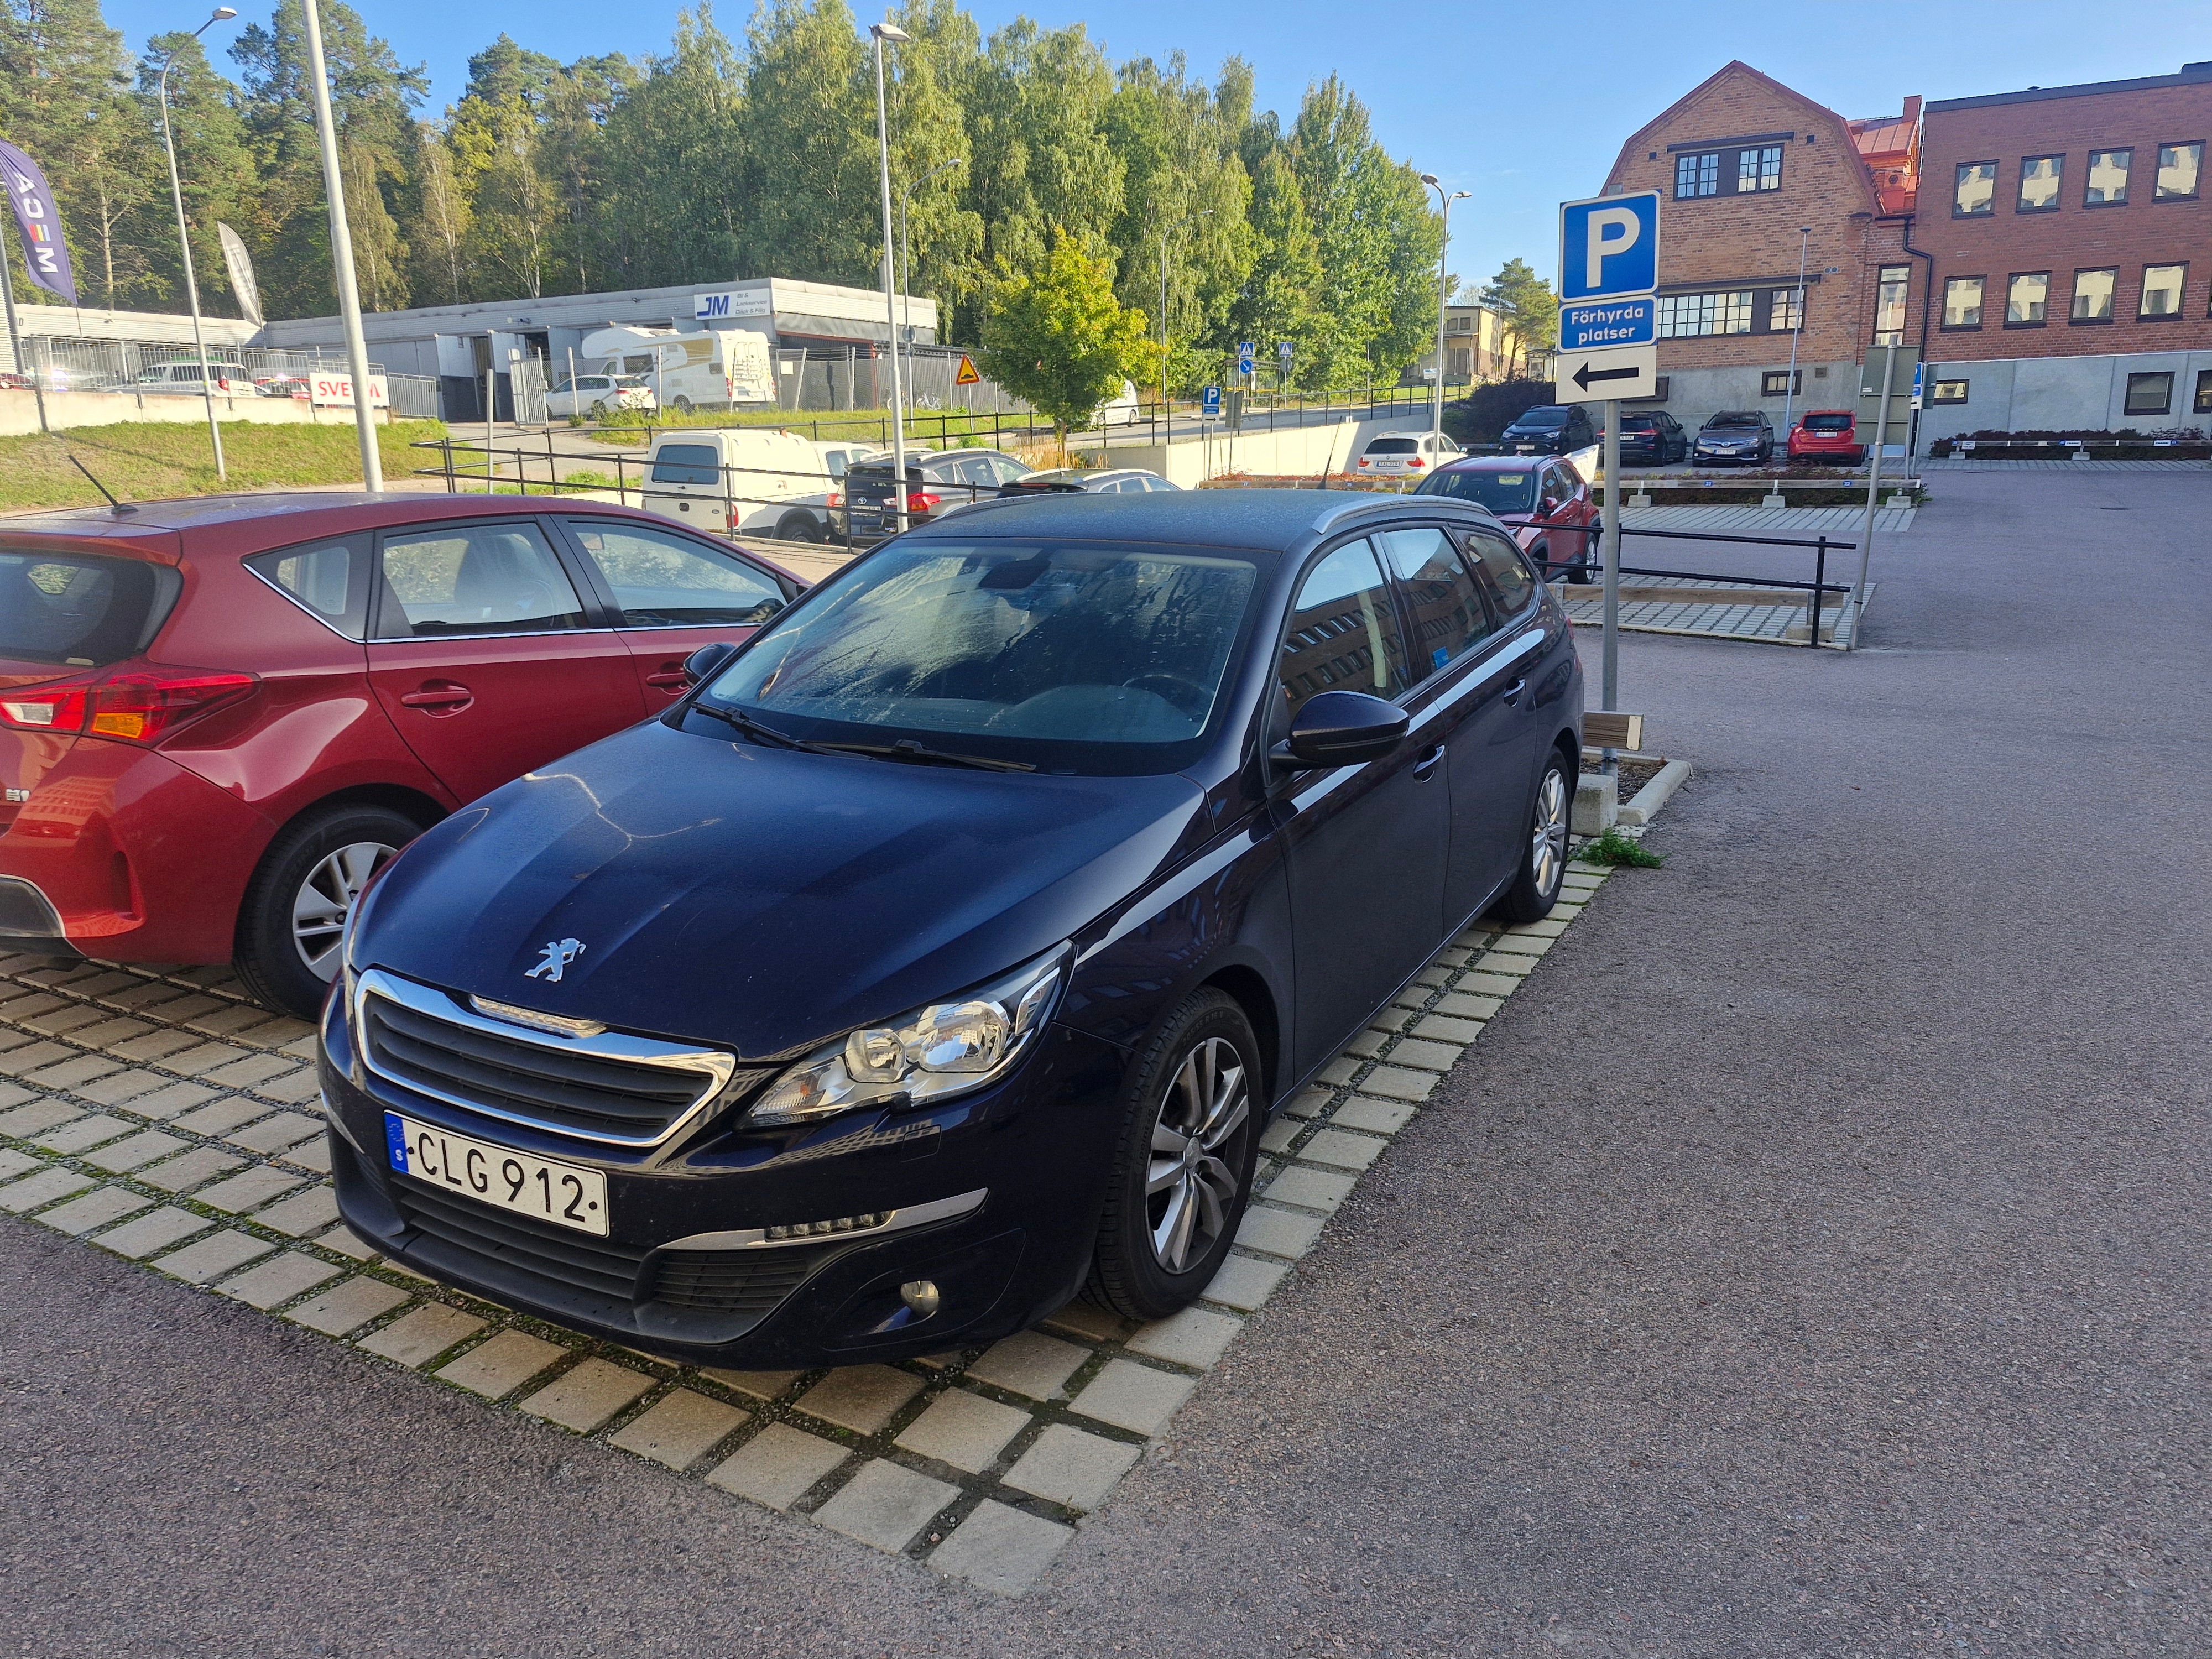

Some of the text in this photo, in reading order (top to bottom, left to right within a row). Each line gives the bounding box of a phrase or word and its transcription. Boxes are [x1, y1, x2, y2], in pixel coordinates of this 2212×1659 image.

[1586, 207, 1640, 289] P
[697, 295, 729, 316] JM
[1571, 306, 1644, 325] Förhyrda
[1578, 326, 1636, 346] platser
[318, 381, 381, 398] SVEA
[1207, 388, 1218, 403] P
[395, 1149, 403, 1162] S
[418, 1131, 586, 1223] CLG 912
